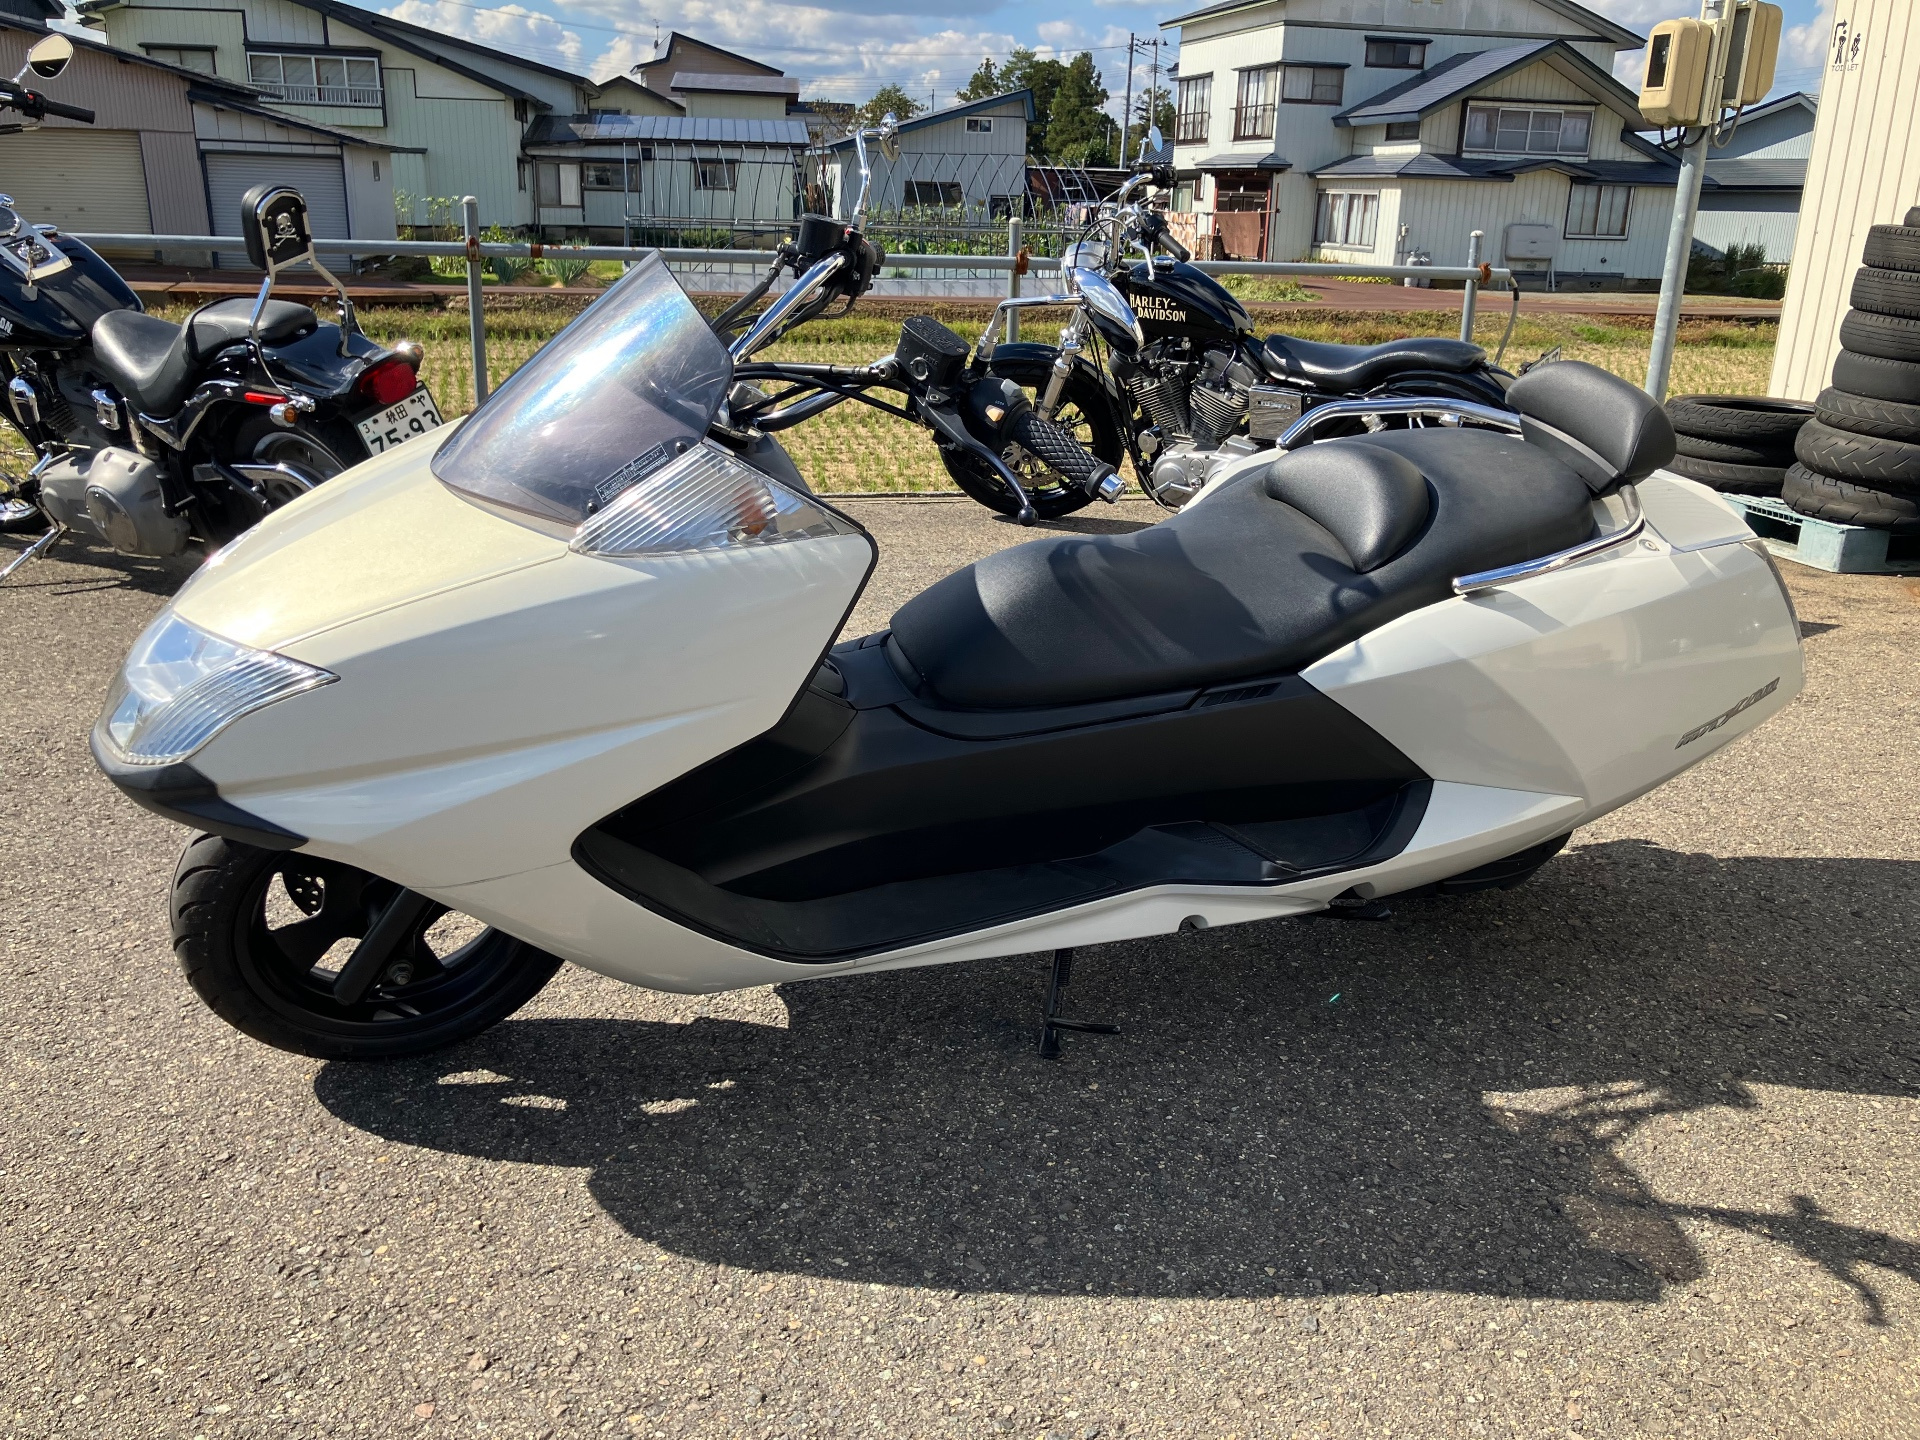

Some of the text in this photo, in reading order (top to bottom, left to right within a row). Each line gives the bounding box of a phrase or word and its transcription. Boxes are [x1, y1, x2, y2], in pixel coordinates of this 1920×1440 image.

[1130, 293, 1177, 309] HARLEY-
[1137, 307, 1186, 322] DAVIDSON
[385, 395, 425, 424] 秋田 や
